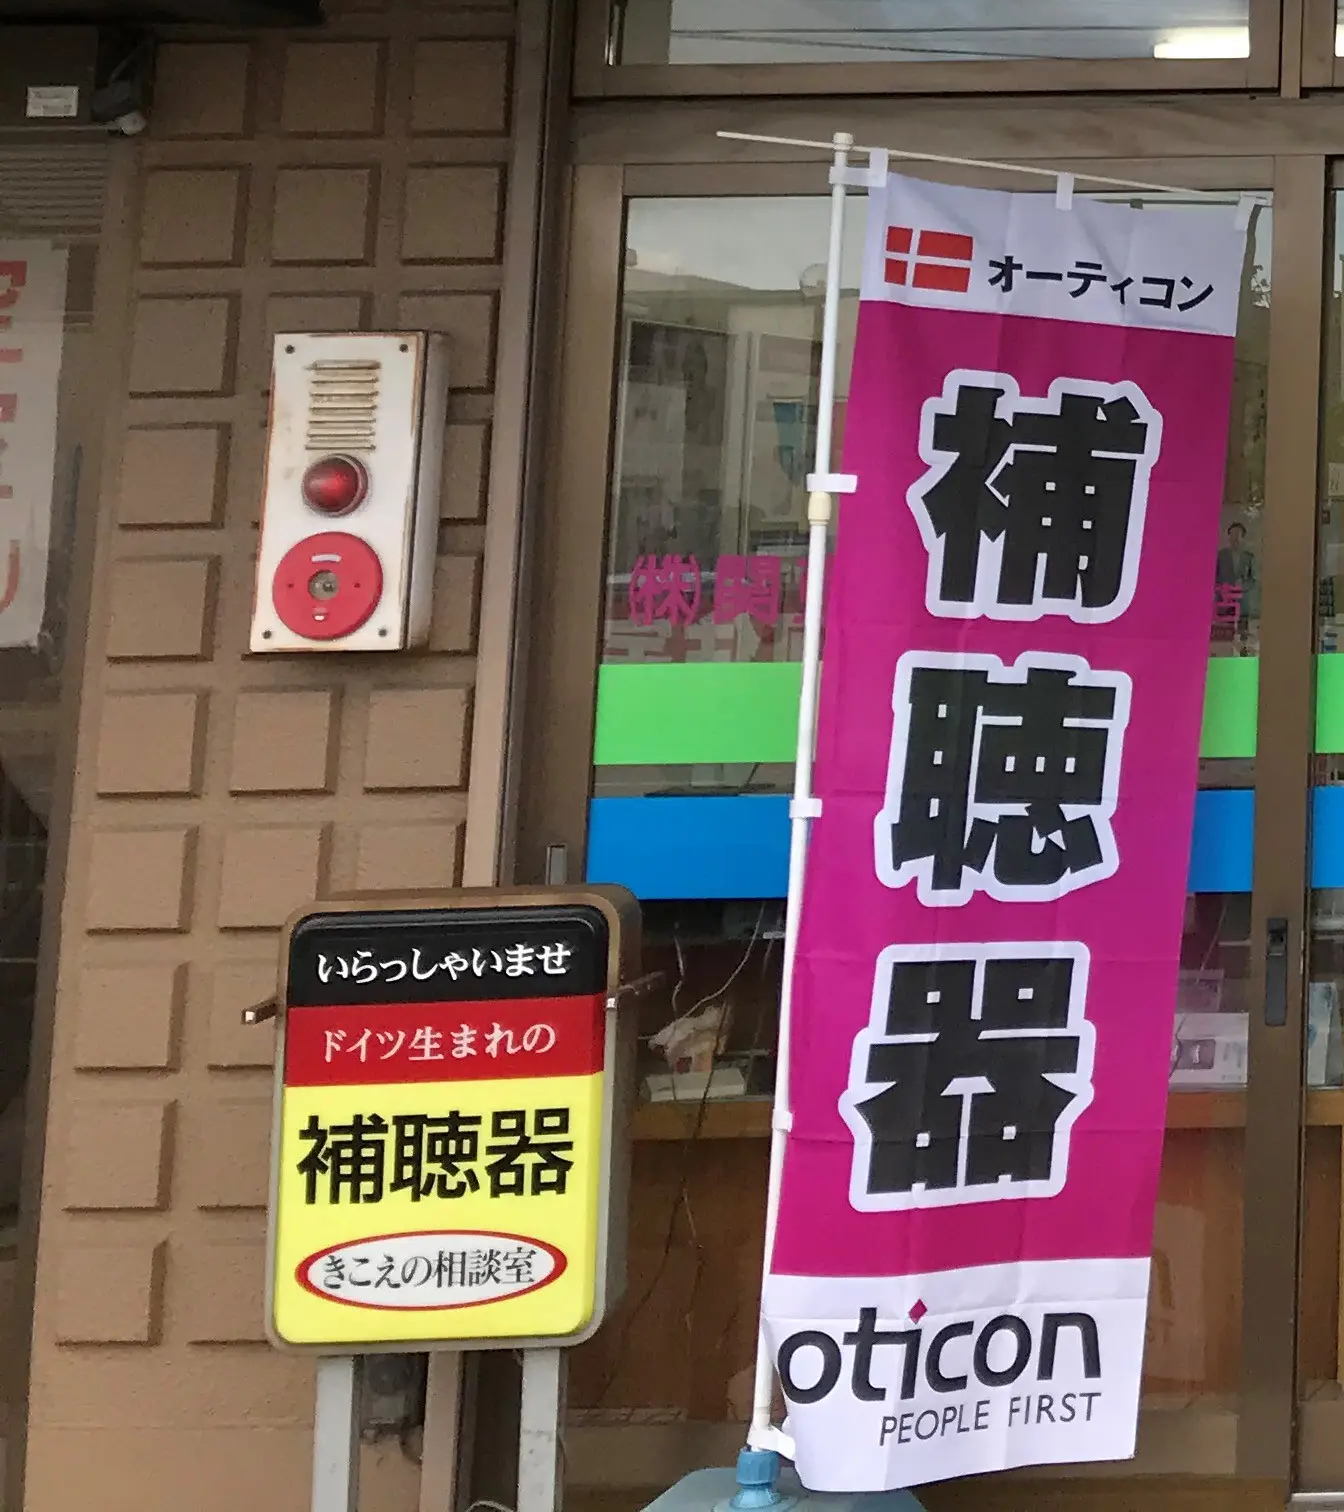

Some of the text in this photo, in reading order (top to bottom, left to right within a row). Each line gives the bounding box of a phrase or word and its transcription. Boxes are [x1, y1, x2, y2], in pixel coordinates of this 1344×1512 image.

[988, 254, 1215, 313] オーティコン
[847, 377, 1154, 1202] 補聴器
[317, 943, 573, 985] いらっしゃいませ
[323, 1022, 557, 1063] ドイツ生まれの
[296, 1106, 576, 1205] 補聴器
[322, 1247, 537, 1289] きこえの相談室
[778, 1299, 1103, 1405] oticon
[879, 1391, 1102, 1448] PEOPLE FIRST
